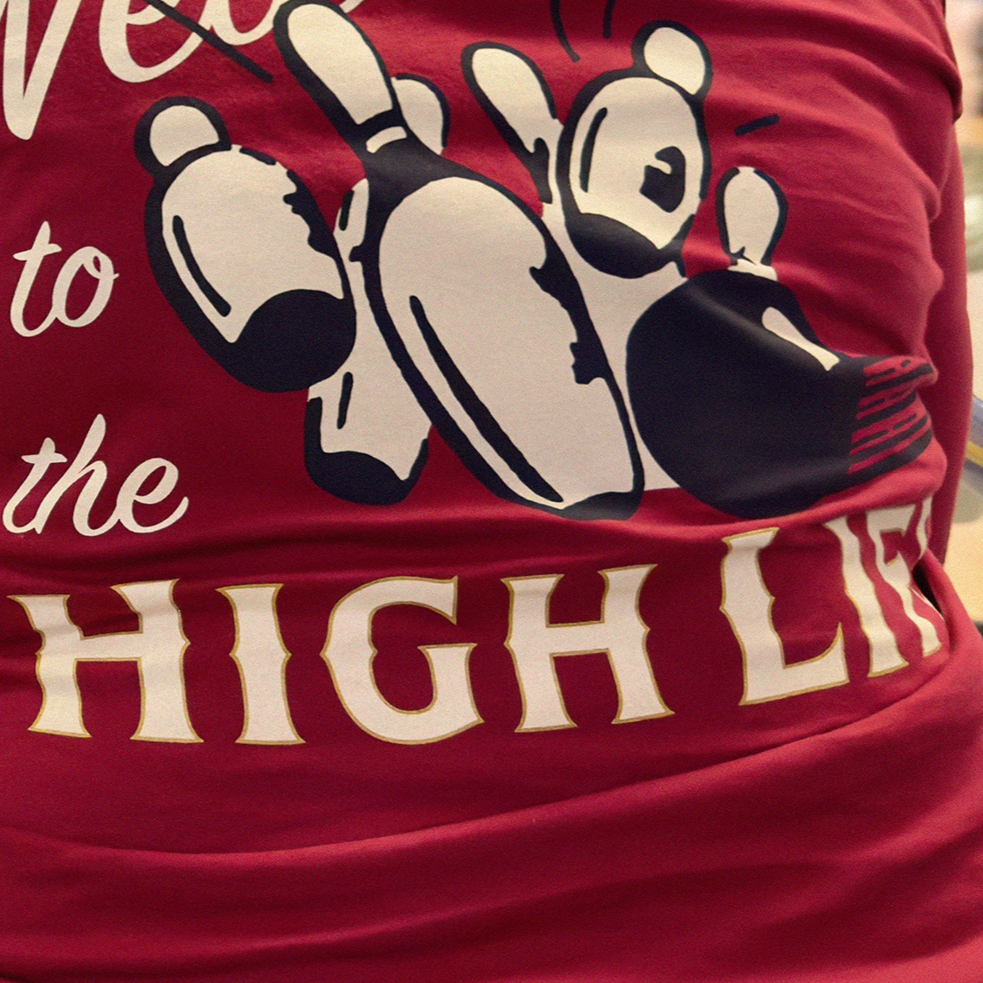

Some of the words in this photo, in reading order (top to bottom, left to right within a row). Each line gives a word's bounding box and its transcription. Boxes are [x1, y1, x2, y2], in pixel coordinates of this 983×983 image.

[10, 221, 119, 337] to
[2, 413, 189, 537] the
[6, 563, 675, 746] HIGH
[720, 496, 944, 706] LIF
